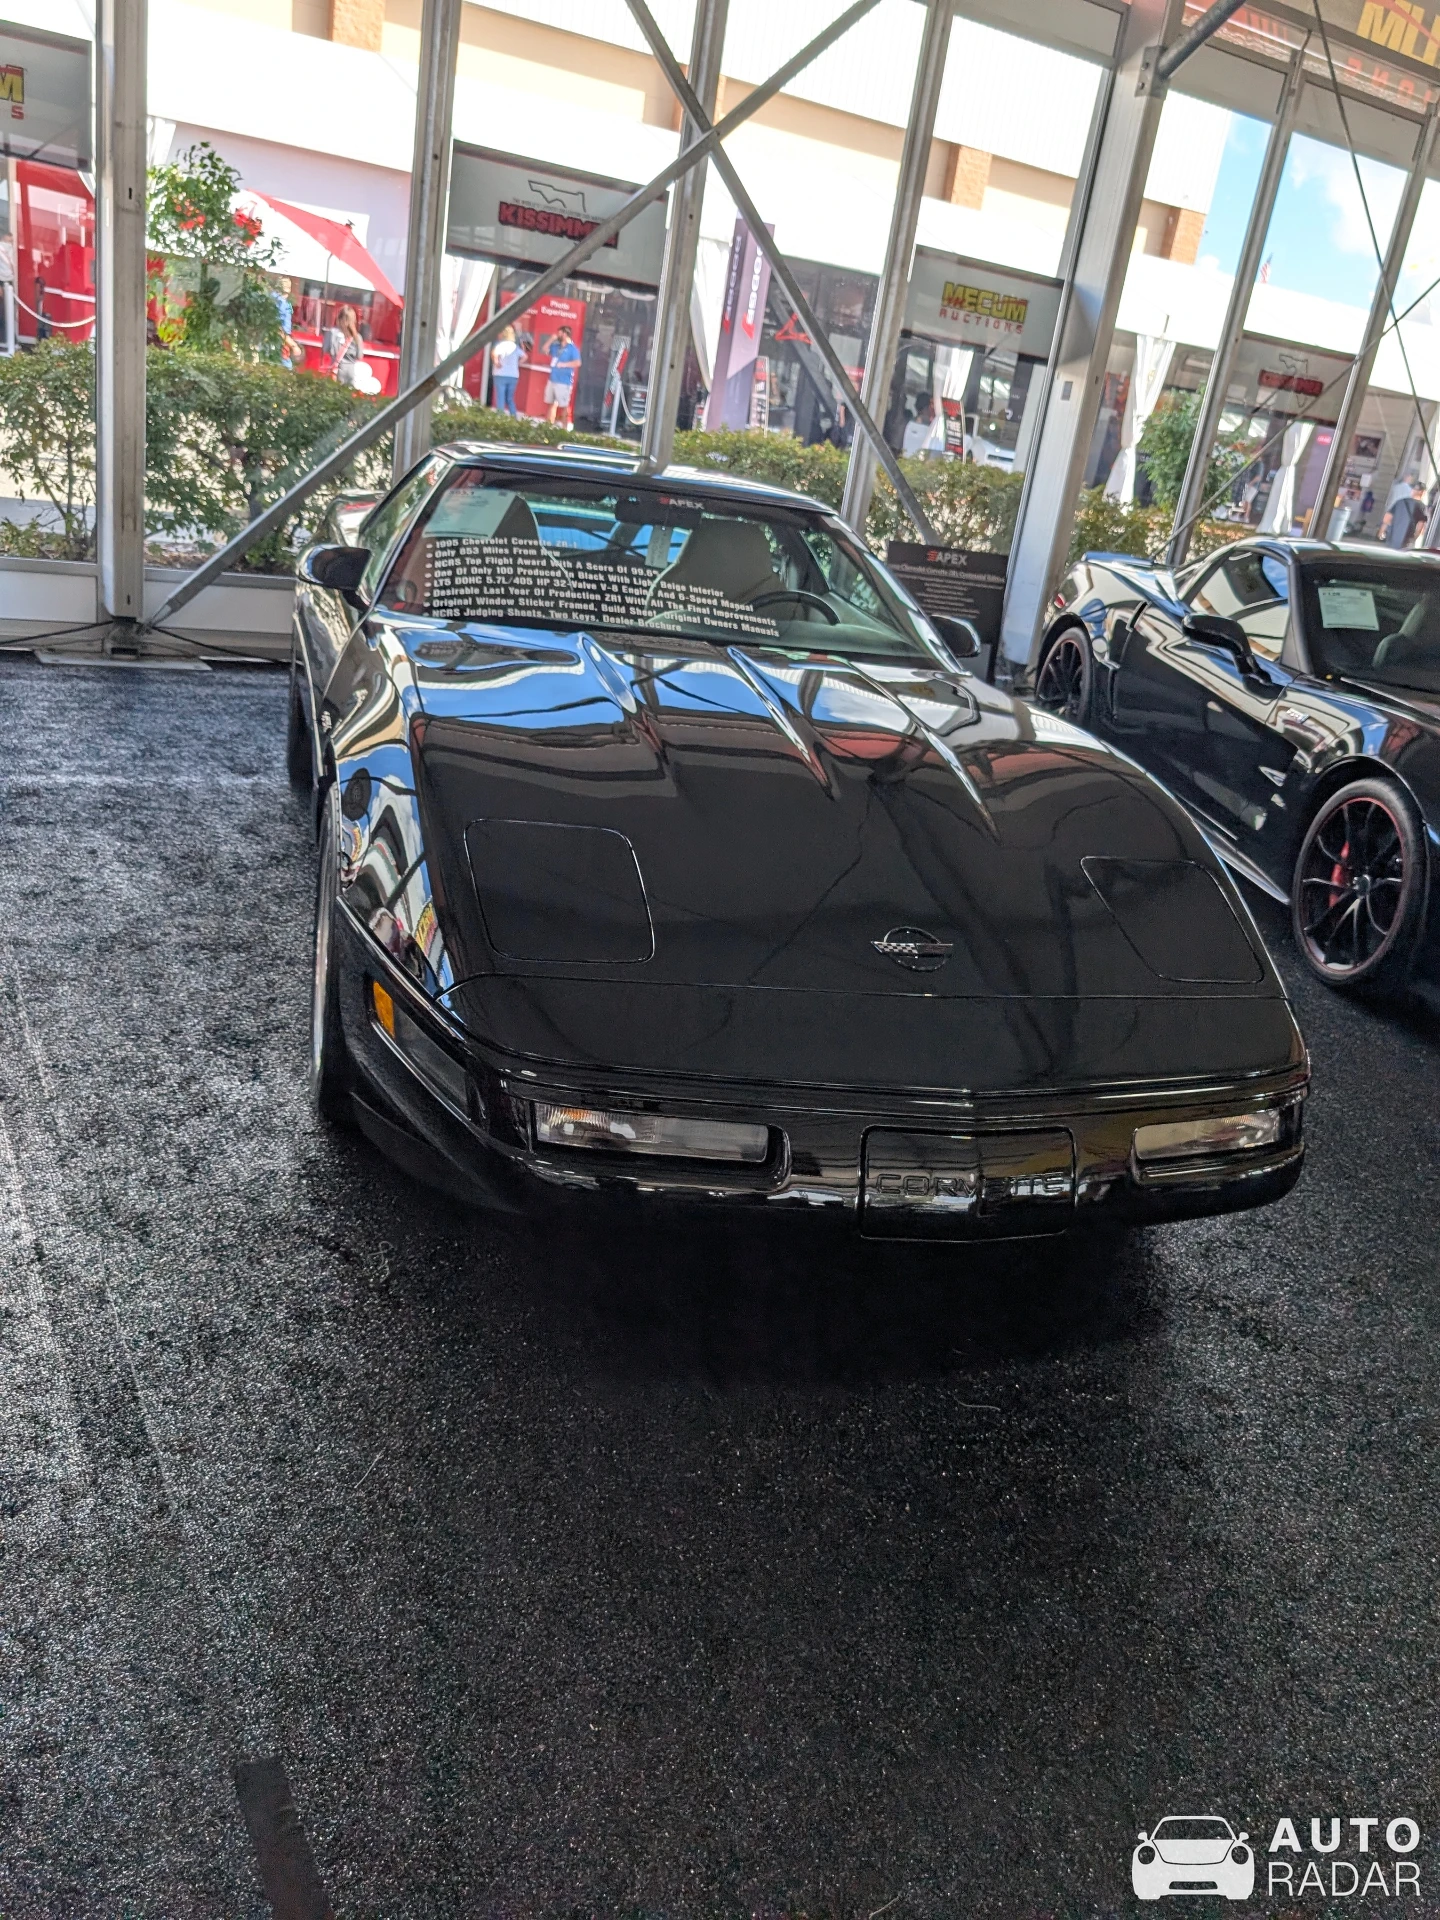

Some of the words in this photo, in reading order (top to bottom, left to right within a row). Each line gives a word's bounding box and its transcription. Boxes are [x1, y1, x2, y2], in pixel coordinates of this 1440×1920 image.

[541, 306, 577, 319] Experience
[550, 300, 570, 311] Photo
[942, 281, 1028, 324] MECUM
[939, 307, 1024, 334] AUCTIONS
[669, 498, 705, 510] APEX
[435, 539, 459, 549] 1995
[462, 537, 508, 546] Chevrolet
[511, 537, 552, 547] Corvette
[435, 548, 456, 558] Only
[460, 547, 479, 555] 853
[483, 546, 510, 555] Miles
[513, 547, 537, 556] From
[540, 548, 560, 557] Now
[434, 559, 461, 568] NCRS
[465, 557, 482, 566] Top
[485, 557, 513, 566] Flight
[517, 557, 547, 567] Award
[550, 559, 573, 568] With
[575, 561, 583, 569] A
[586, 562, 614, 573] Score
[617, 563, 628, 574] Of
[935, 551, 968, 566] APEX
[434, 569, 453, 579] One
[456, 567, 469, 576] Of
[471, 567, 493, 577] Only
[496, 567, 514, 575] 100
[517, 567, 561, 578] Produced
[577, 571, 605, 581] Black
[608, 574, 631, 585] With
[660, 581, 686, 592] Beige
[689, 585, 724, 598] Interior
[433, 578, 452, 588] LT5
[455, 576, 482, 585] DOHC
[536, 578, 550, 586] HP
[553, 579, 597, 590] 32-Valve
[600, 583, 619, 593] V-8
[622, 585, 654, 597] Engine
[657, 589, 675, 599] And
[678, 594, 717, 606] 6-Speed
[721, 599, 754, 612] Manual
[433, 587, 480, 598] Desirable
[483, 586, 505, 595] Last
[508, 586, 530, 596] Year
[534, 586, 545, 596] Of
[549, 589, 601, 601] Production
[604, 594, 622, 603] ZR1
[625, 595, 647, 606] With
[651, 599, 664, 608] All
[666, 601, 684, 611] The
[687, 603, 710, 615] Final
[713, 607, 777, 627] Improvements
[432, 608, 460, 617] NCRS
[464, 607, 504, 617] Judging
[549, 610, 569, 620] Two
[602, 614, 634, 625] Dealer
[638, 618, 682, 631] Brochure
[433, 597, 472, 607] Original
[476, 597, 514, 606] Window
[518, 597, 556, 608] Sticker
[601, 603, 626, 614] Build
[664, 610, 701, 624] Original
[703, 617, 738, 630] Owners
[741, 622, 780, 637] Manuals
